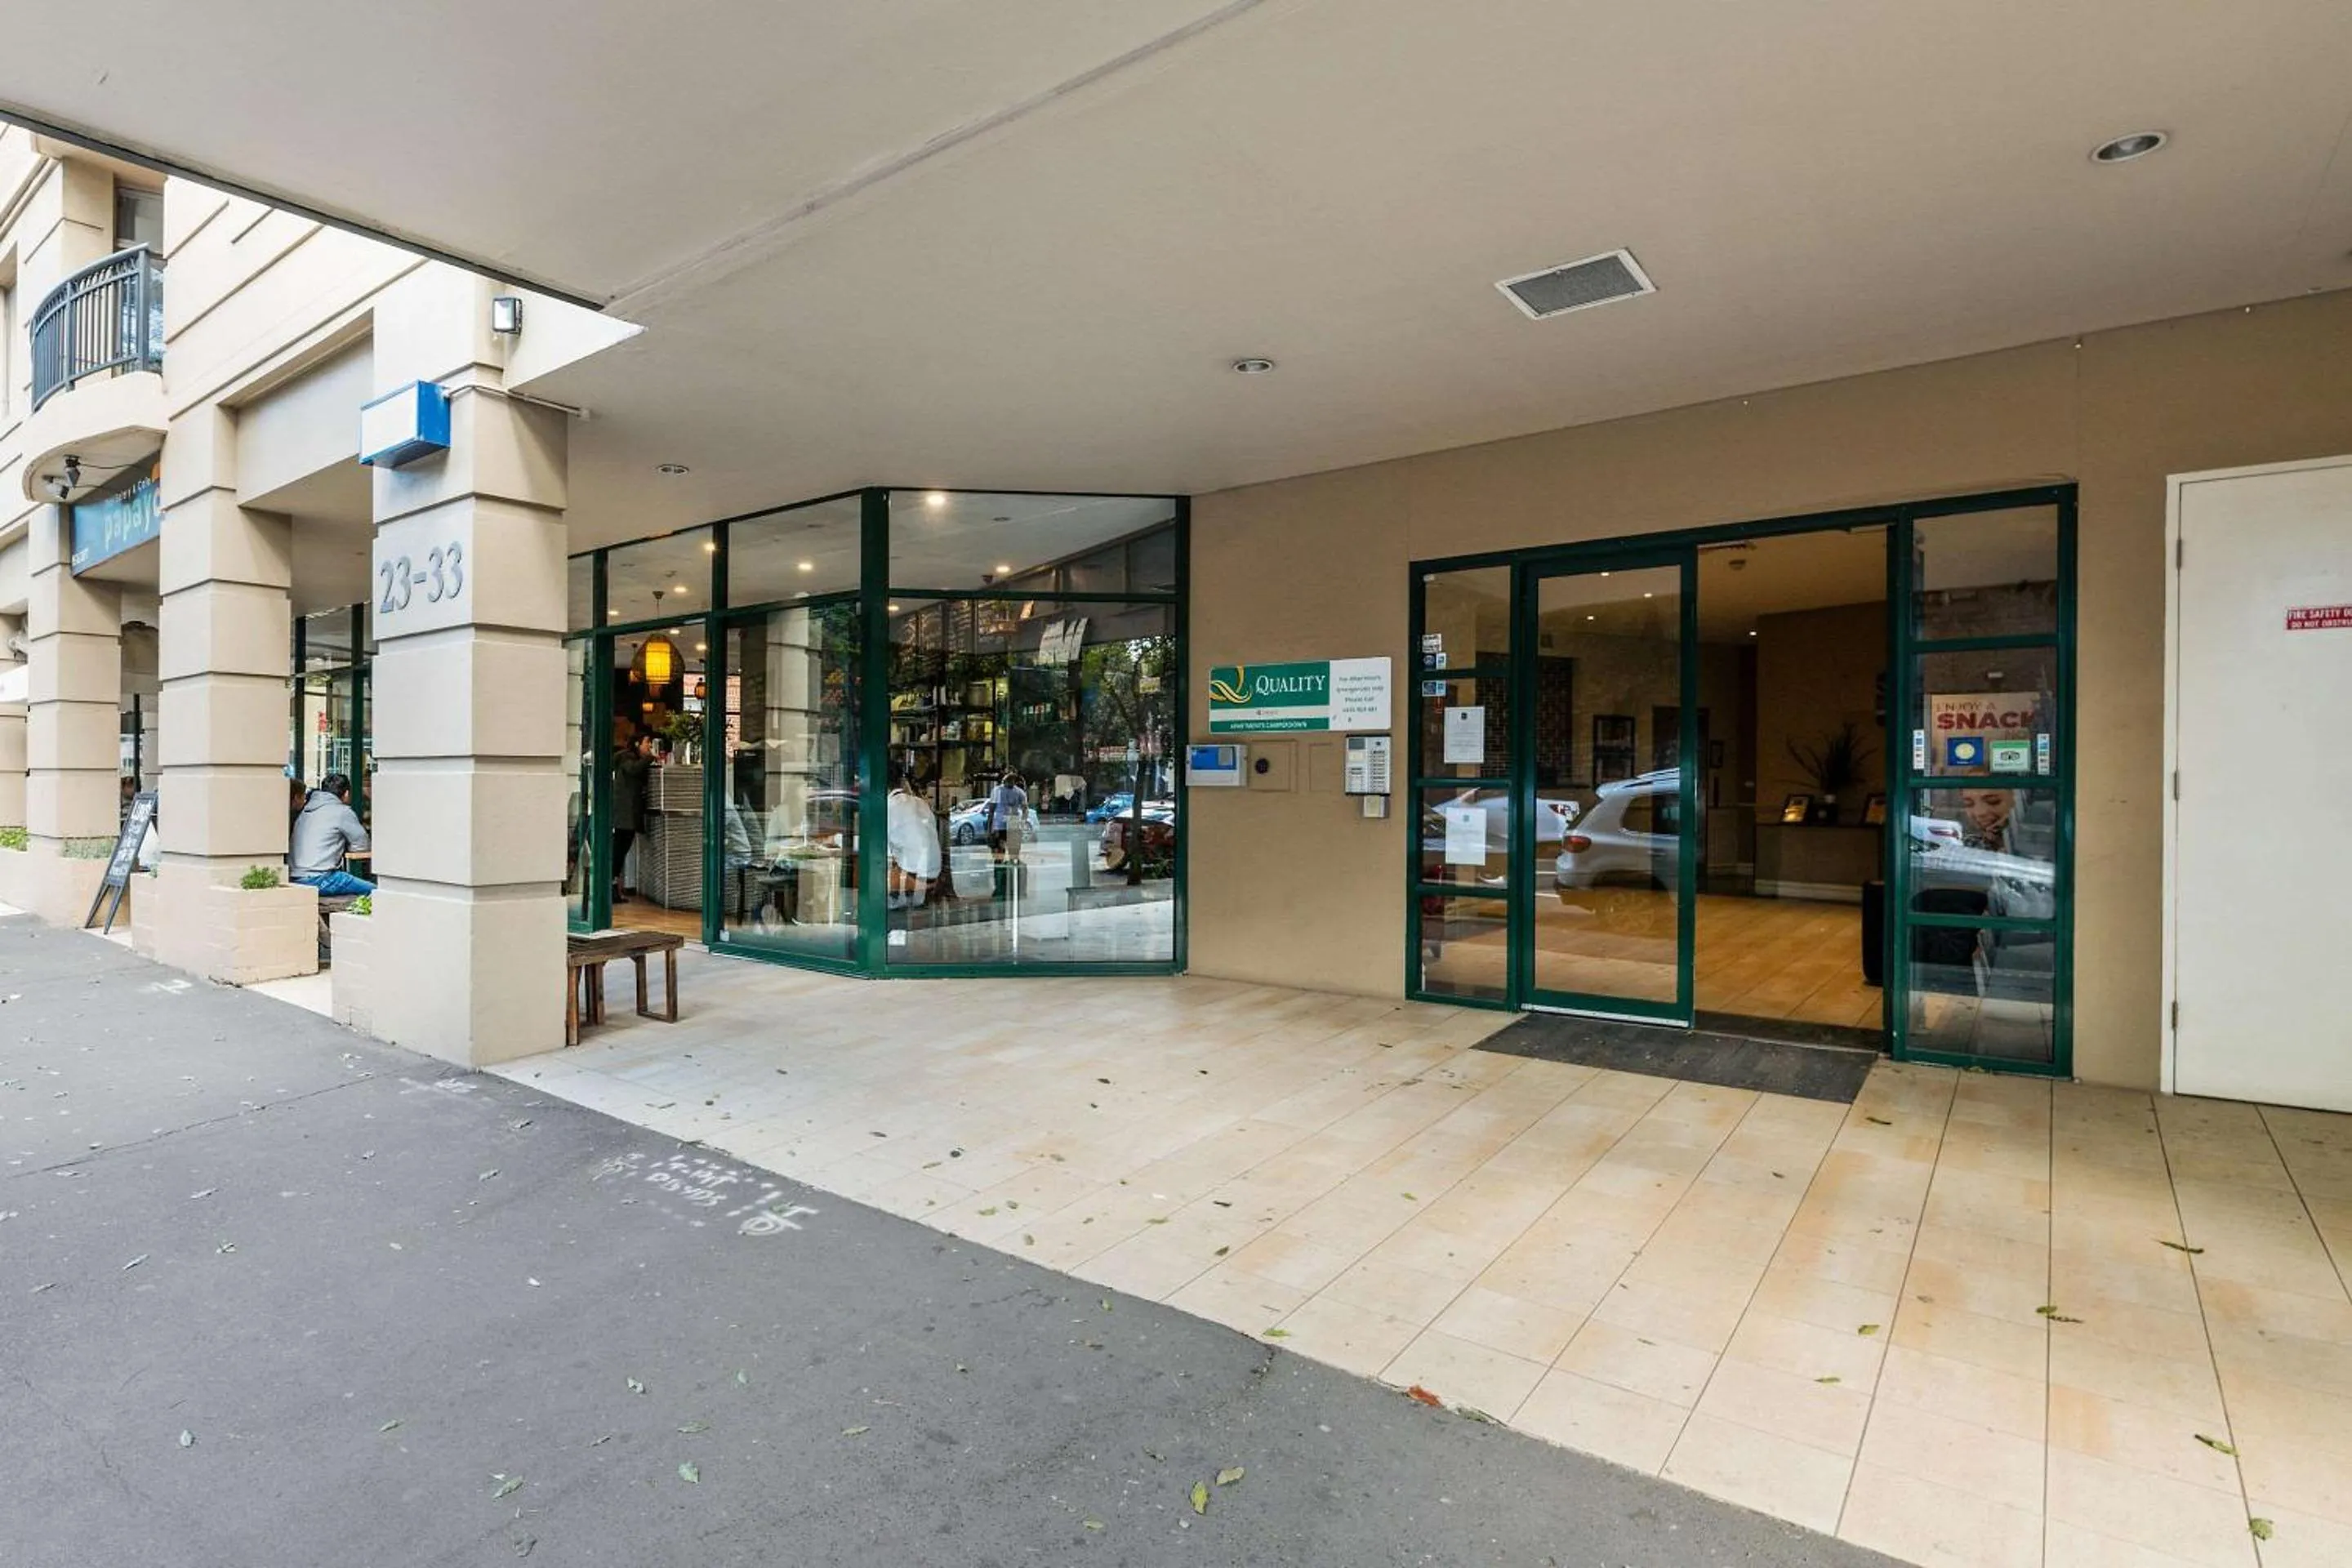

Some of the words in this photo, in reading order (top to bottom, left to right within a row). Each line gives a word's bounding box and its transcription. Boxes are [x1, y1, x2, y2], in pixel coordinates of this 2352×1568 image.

[379, 541, 463, 614] 23-33
[2288, 609, 2307, 620] FIRE
[2309, 608, 2341, 619] SAFETY
[1256, 675, 1326, 695] QUALITY
